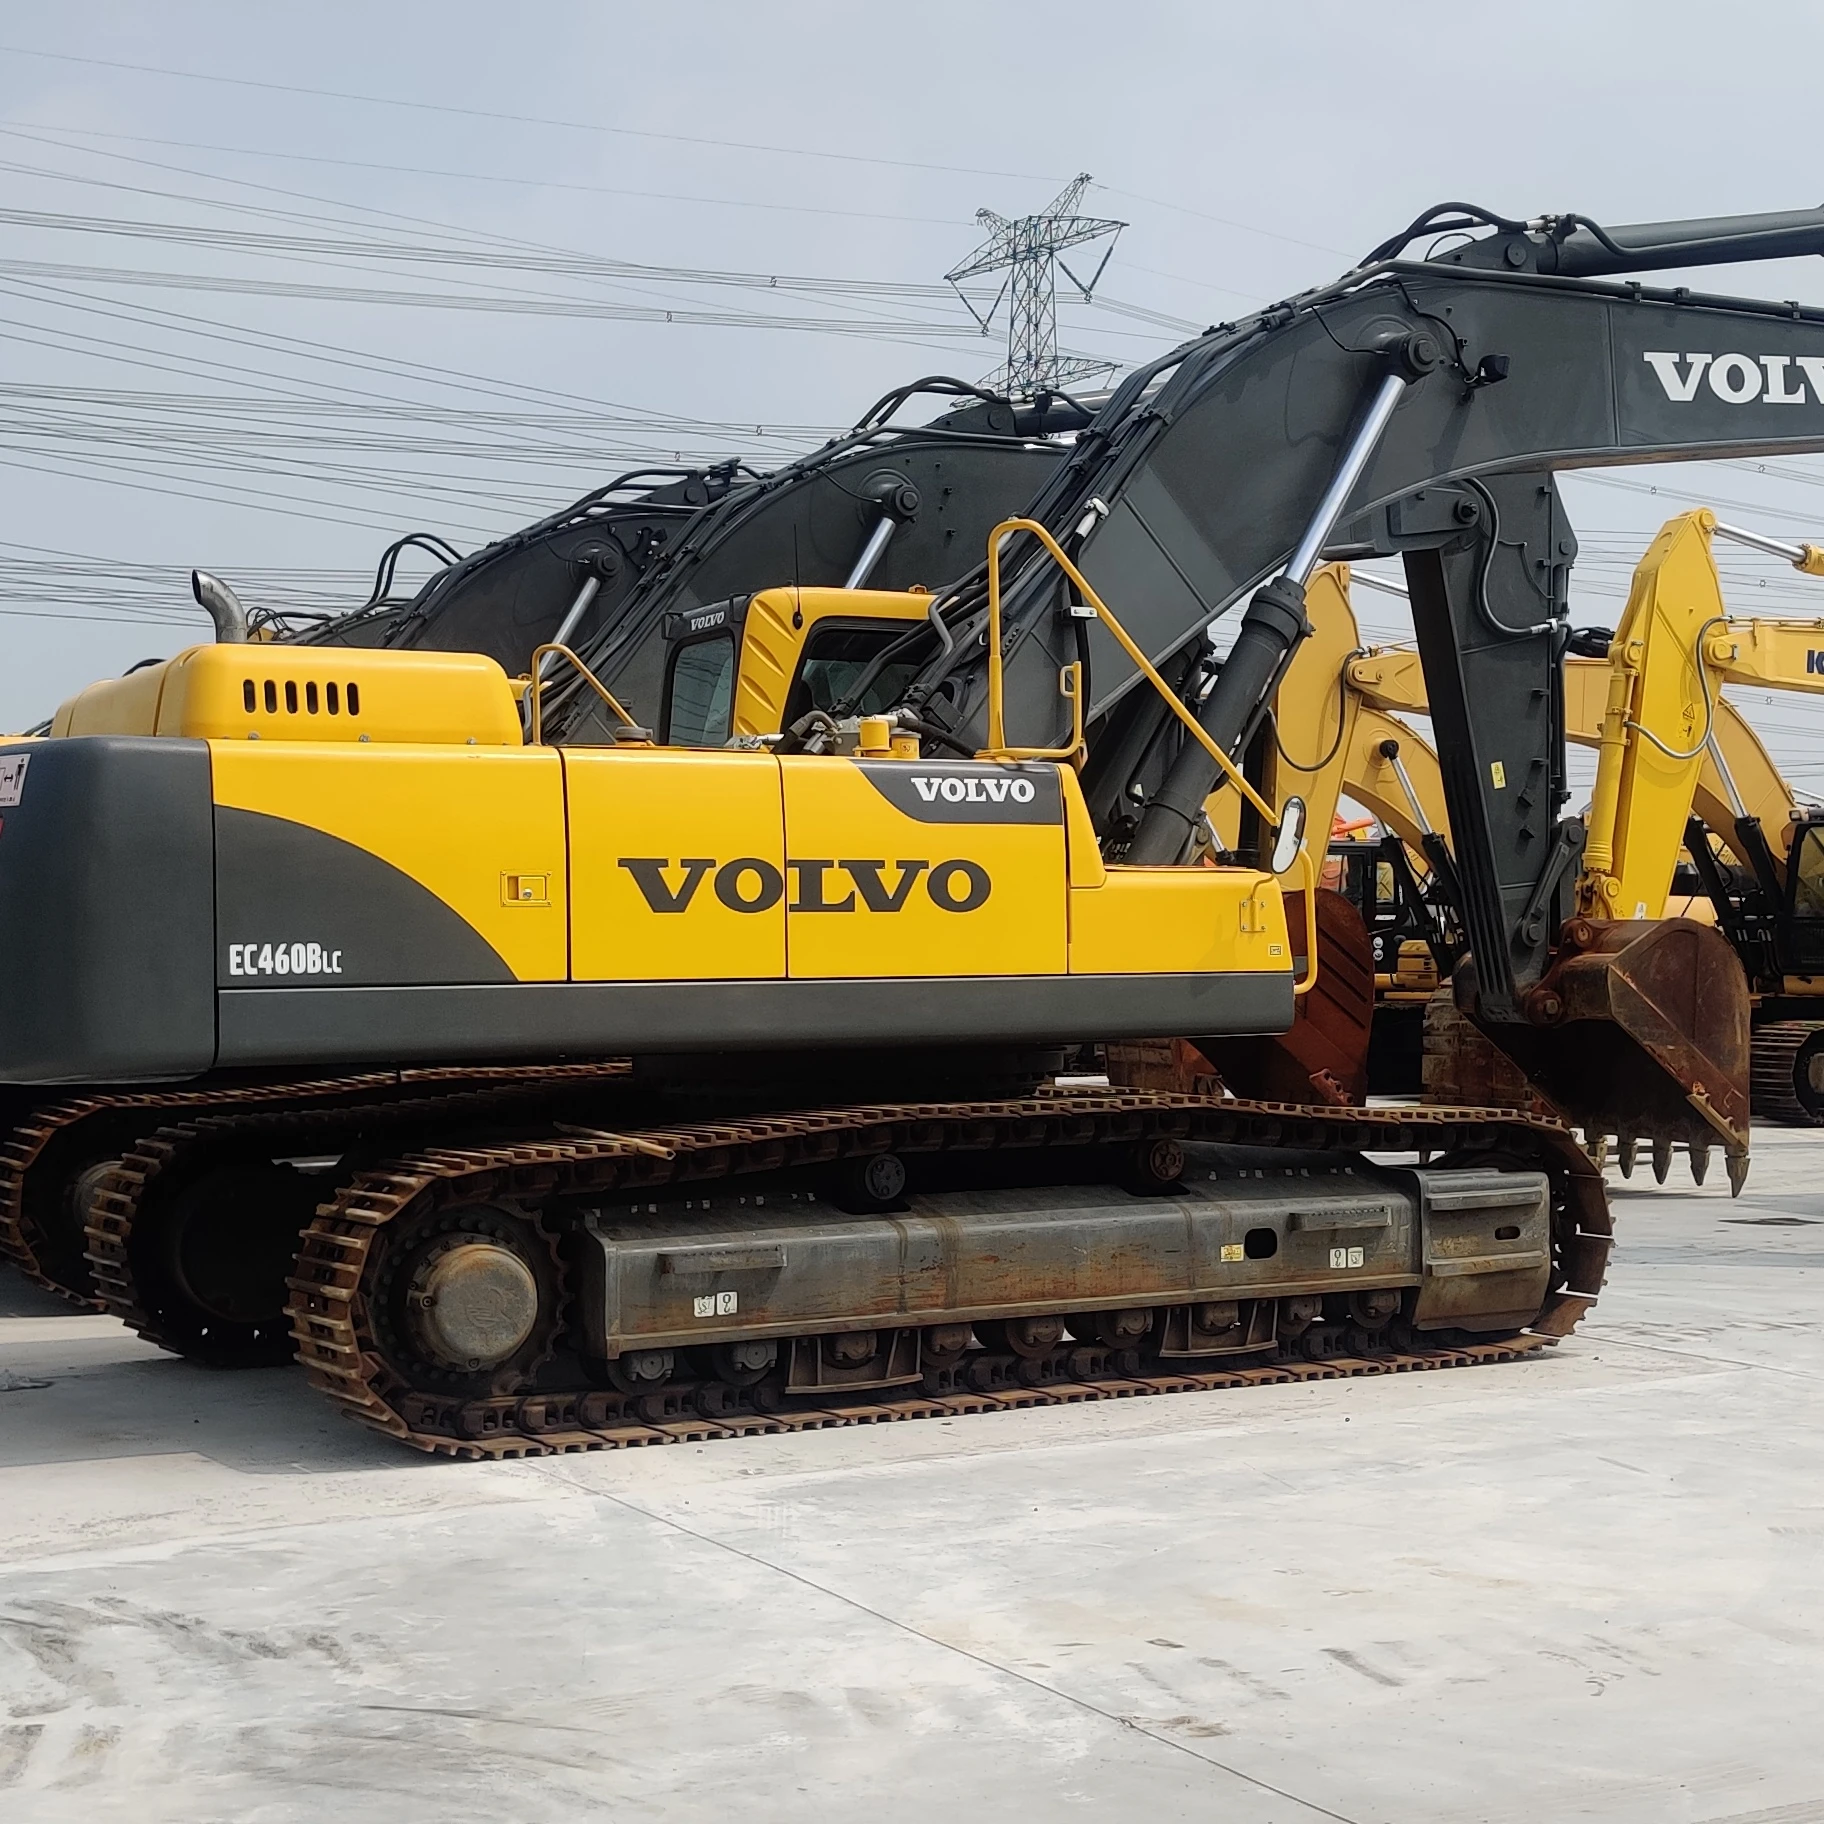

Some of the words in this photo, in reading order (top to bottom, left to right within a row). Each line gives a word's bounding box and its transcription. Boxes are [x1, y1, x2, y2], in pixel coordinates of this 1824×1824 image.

[690, 611, 725, 631] VOLVO
[910, 777, 1036, 804] VOLVO
[618, 857, 992, 914] VOLVO
